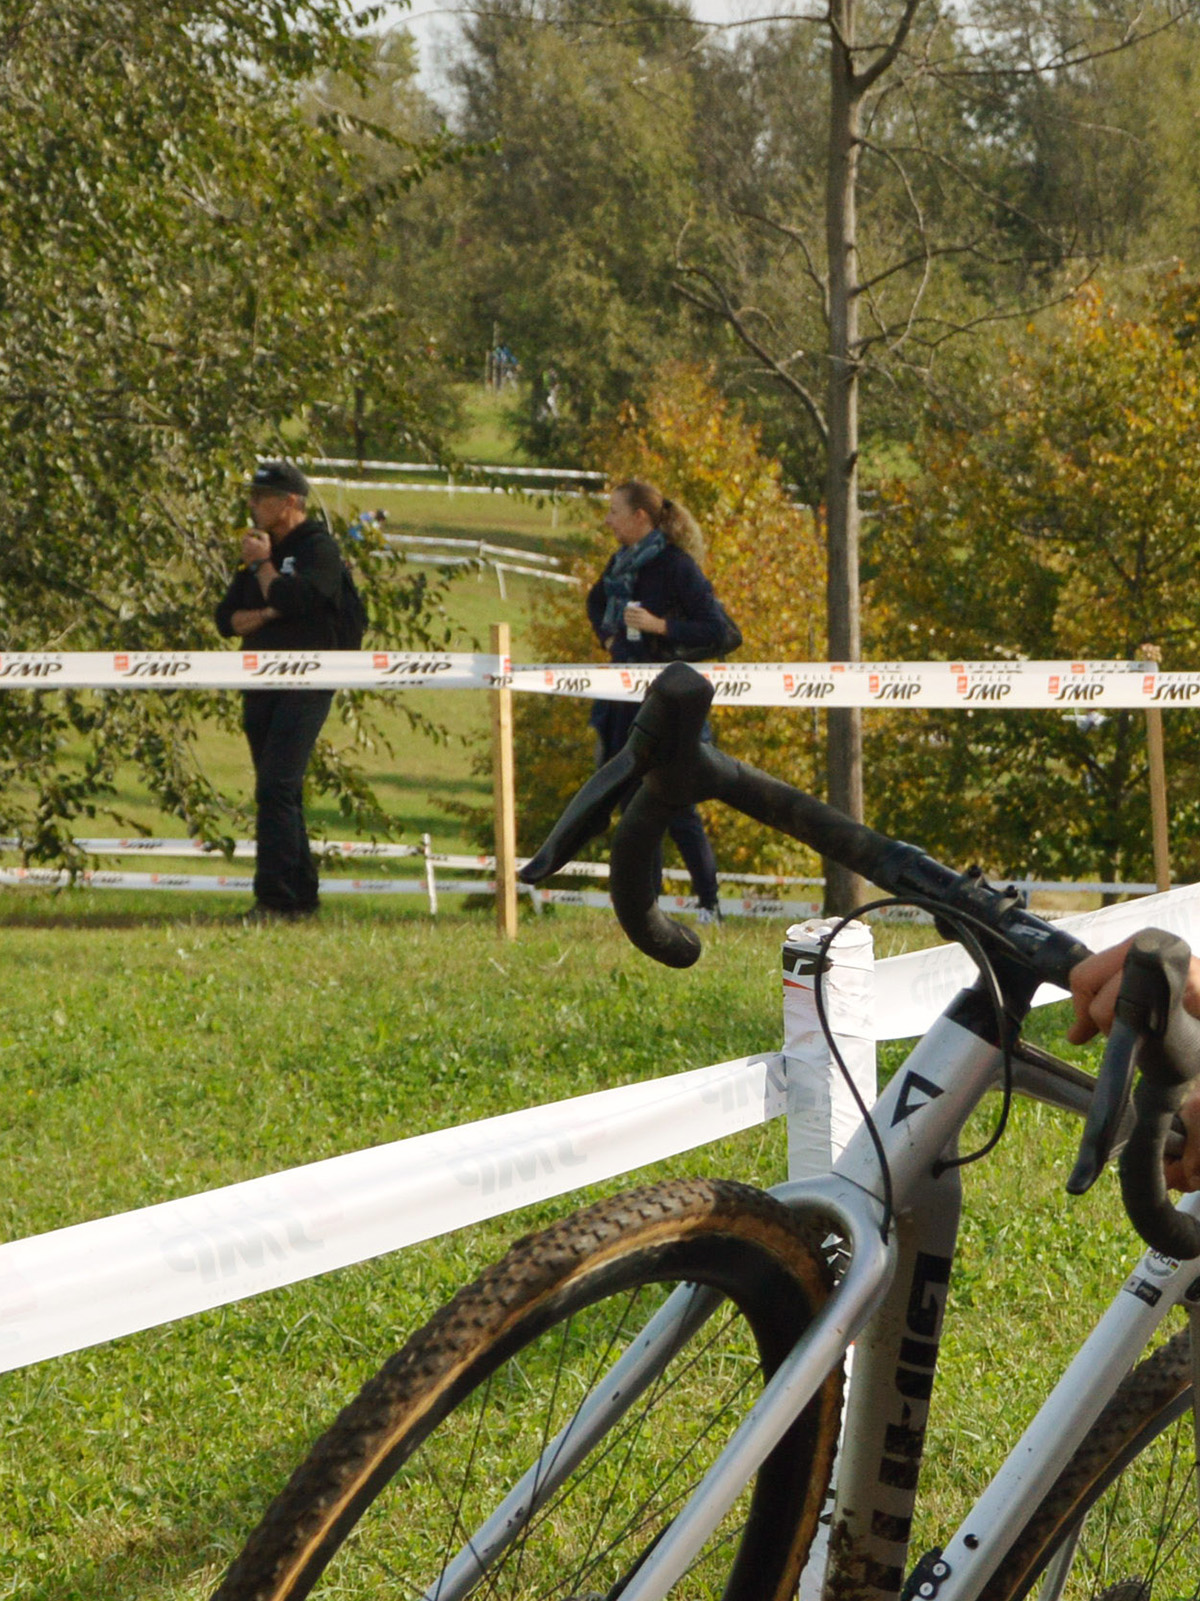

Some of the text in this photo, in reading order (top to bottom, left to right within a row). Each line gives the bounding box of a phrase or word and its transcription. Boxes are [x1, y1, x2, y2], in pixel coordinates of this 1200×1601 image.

[1, 662, 62, 677] SMP
[121, 661, 191, 677] SMP
[250, 660, 321, 676] SMP
[381, 660, 452, 675] SMP
[553, 677, 592, 692] SMP
[789, 682, 835, 699] SMP
[875, 682, 922, 700] SMP
[963, 683, 1011, 700] SMP
[1055, 683, 1104, 700] SMP
[1150, 683, 1200, 700] SMP
